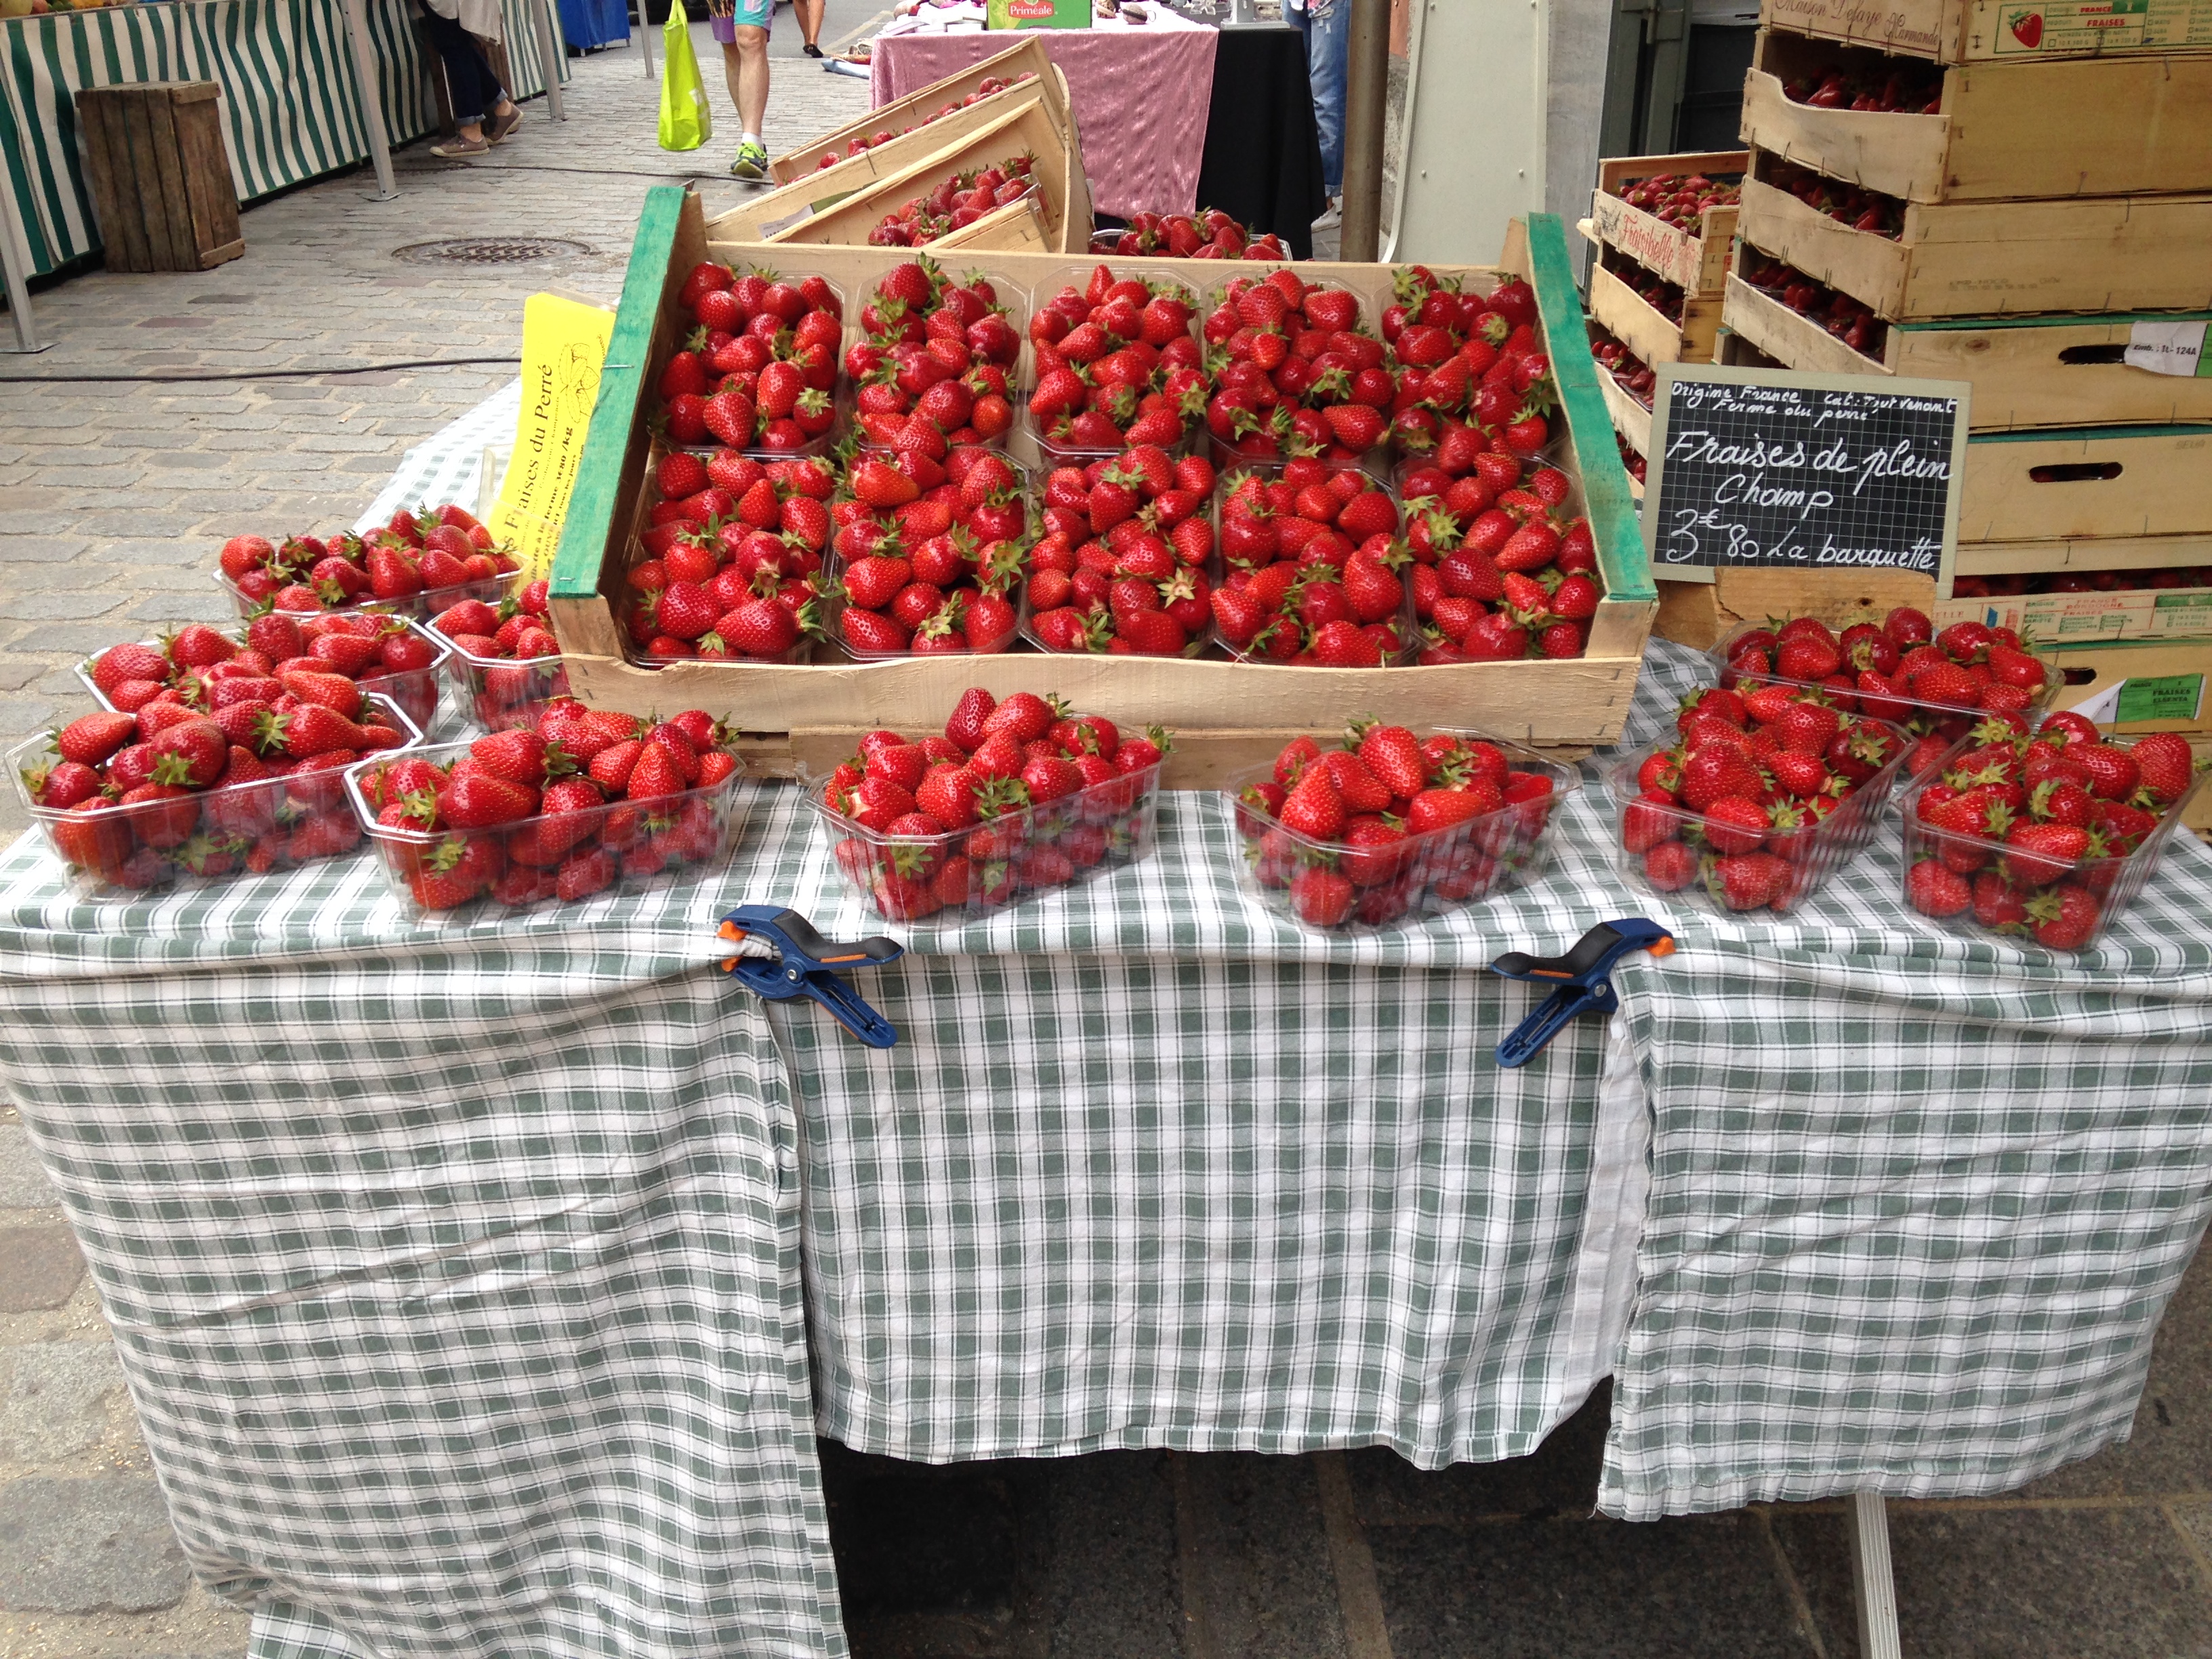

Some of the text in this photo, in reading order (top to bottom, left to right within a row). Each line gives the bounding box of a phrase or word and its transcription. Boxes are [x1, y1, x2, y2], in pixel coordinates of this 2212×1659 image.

[1010, 5, 1052, 15] Priméale
[2087, 18, 2125, 27] FRAISES
[535, 364, 554, 419] Perré
[1671, 382, 1732, 408] Origine
[1740, 386, 1801, 403] France
[1712, 398, 1778, 414] Ferme
[530, 426, 546, 452] du
[544, 487, 558, 519] ferme
[562, 427, 573, 451] /kg
[1666, 430, 1954, 496] Fraises de plein
[1817, 533, 1942, 569] barquette
